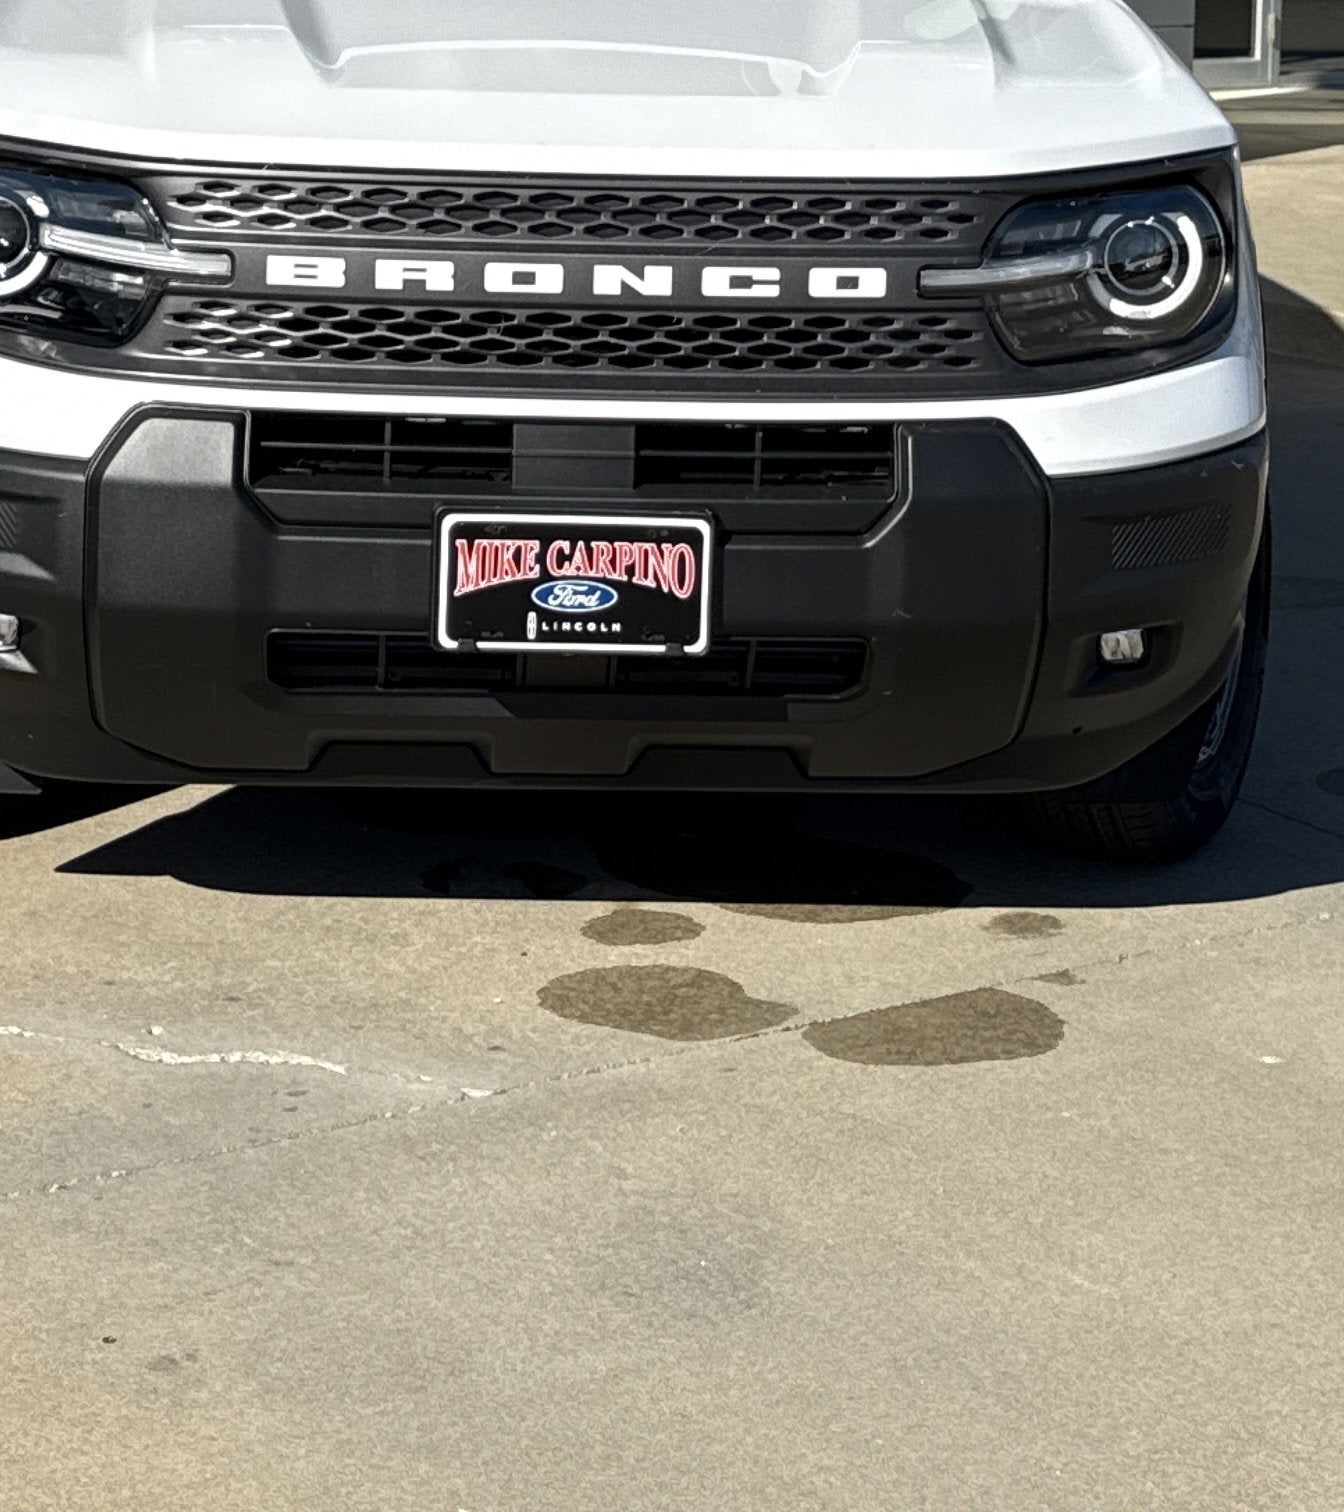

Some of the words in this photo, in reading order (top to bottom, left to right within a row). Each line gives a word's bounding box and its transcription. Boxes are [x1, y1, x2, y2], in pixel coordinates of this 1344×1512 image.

[265, 254, 887, 298] BRONCO
[454, 539, 540, 597] MIKE
[546, 540, 696, 599] CARPINO
[548, 584, 602, 606] Ford
[541, 621, 622, 633] LINCOLN
